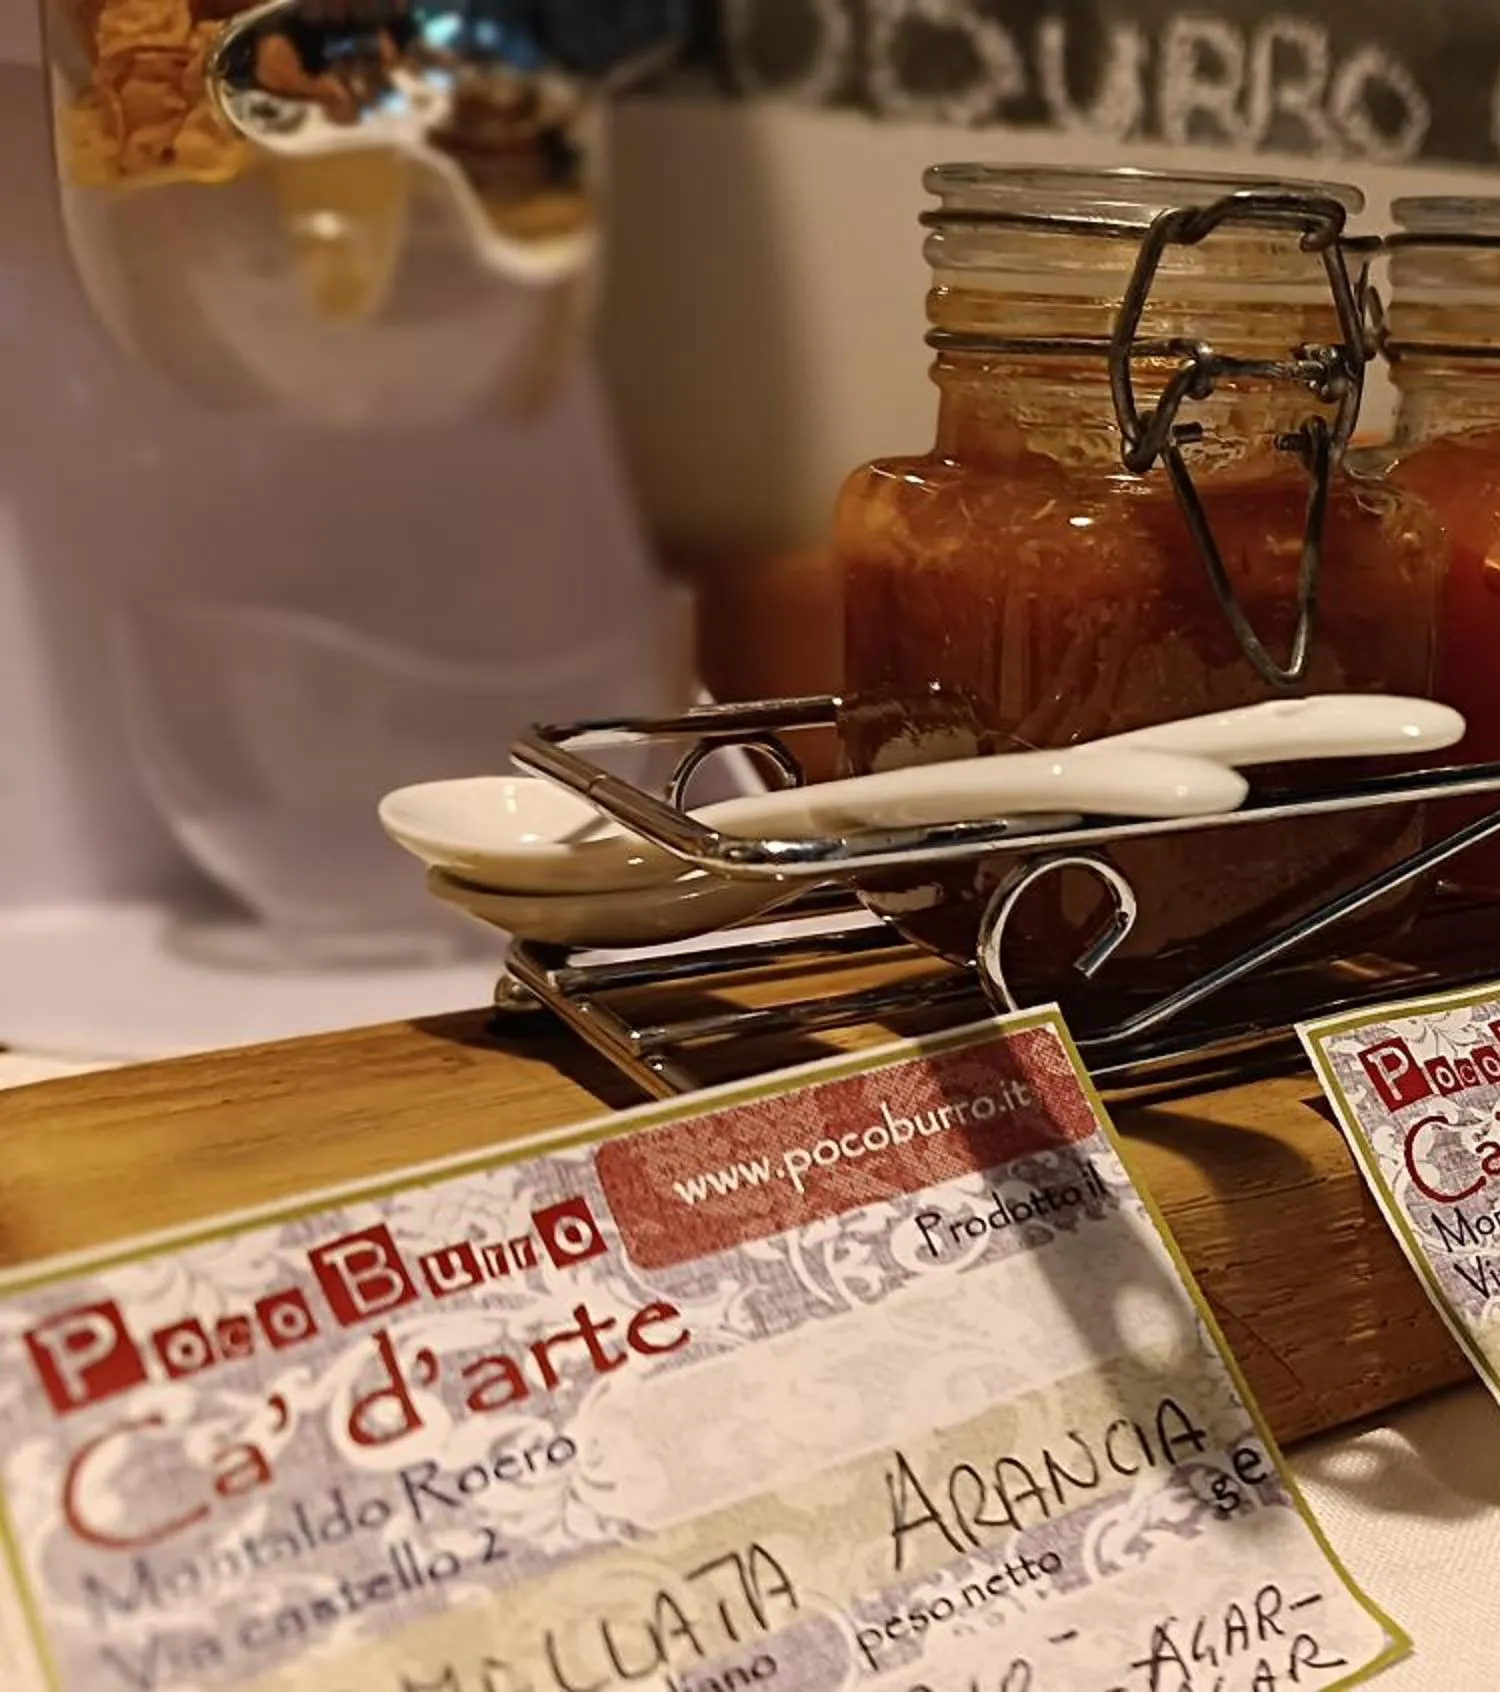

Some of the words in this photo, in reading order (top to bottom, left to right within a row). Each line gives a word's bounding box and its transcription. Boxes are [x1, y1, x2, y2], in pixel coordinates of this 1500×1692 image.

[671, 1079, 1032, 1206] www.pocoburro.it
[913, 1179, 1082, 1257] Prodotto
[1086, 1160, 1111, 1201] il
[62, 1391, 288, 1551] Ca'
[346, 1299, 691, 1447] d'arte
[888, 1398, 1206, 1570] ARANCIA
[82, 1488, 390, 1628] Montaldo
[400, 1433, 577, 1522] Roero
[100, 1634, 223, 1692] Via
[237, 1541, 462, 1652] castello
[479, 1527, 510, 1565] 2
[856, 1596, 954, 1671] peso
[962, 1548, 1062, 1608] netto
